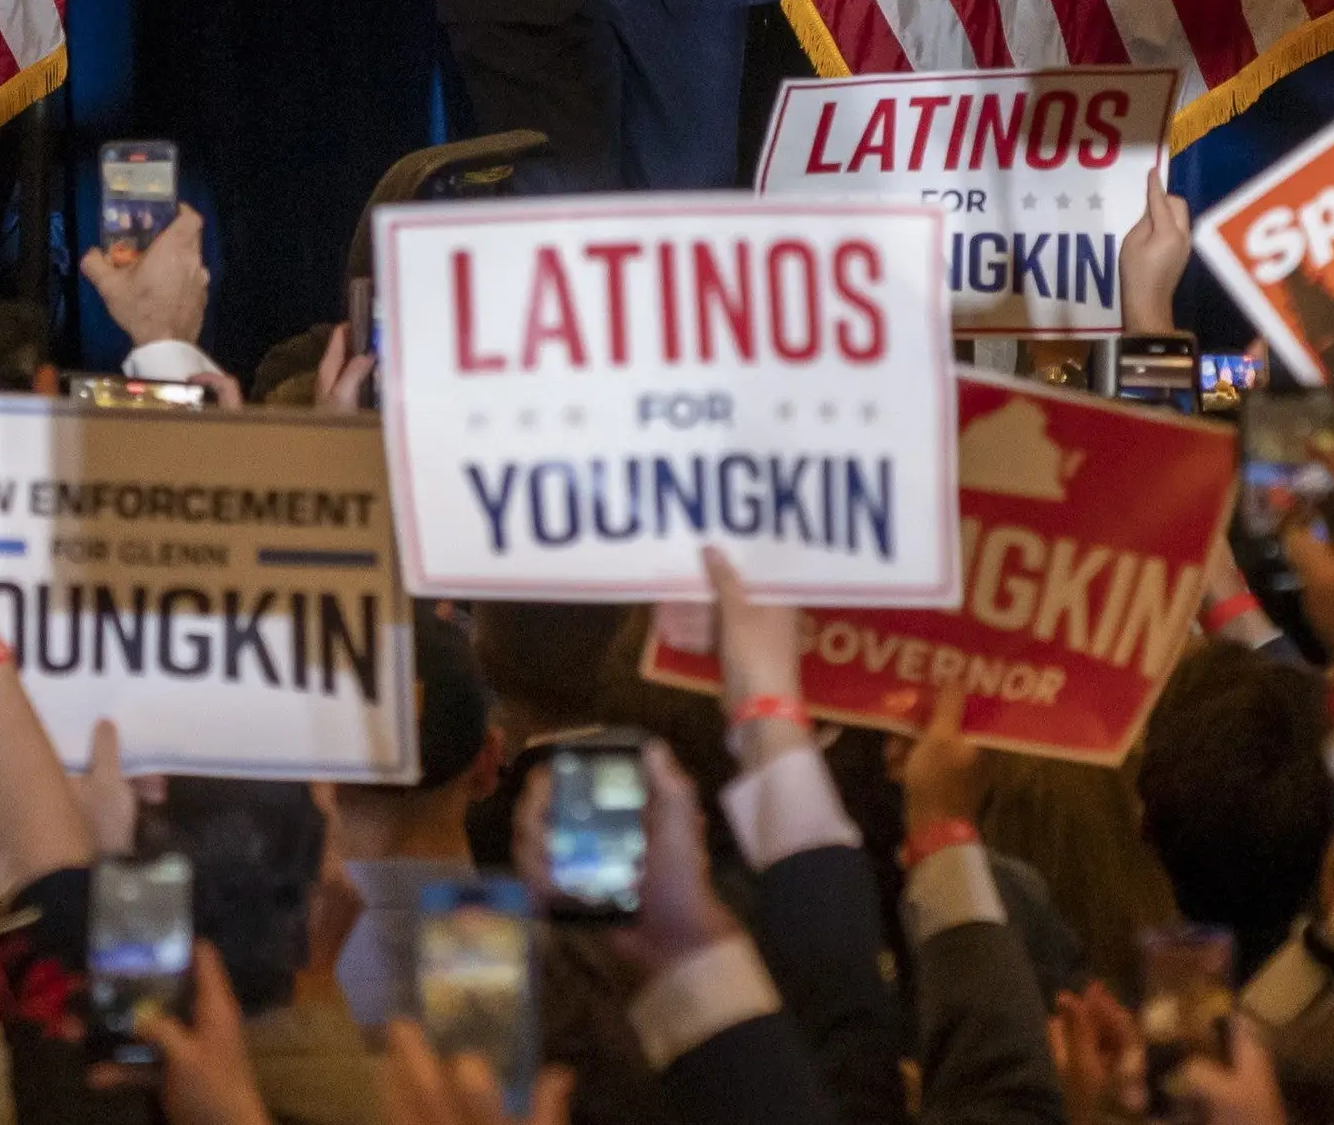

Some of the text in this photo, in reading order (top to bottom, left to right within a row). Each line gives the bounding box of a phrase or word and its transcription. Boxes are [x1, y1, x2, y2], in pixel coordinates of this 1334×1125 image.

[804, 89, 1130, 175] LATINOS
[450, 236, 887, 375] LATINOS
[637, 391, 735, 429] FOR
[28, 480, 376, 528] ENFORCEMENT
[462, 450, 895, 562] YOUNGKIN
[50, 535, 230, 567] FOR GLENN
